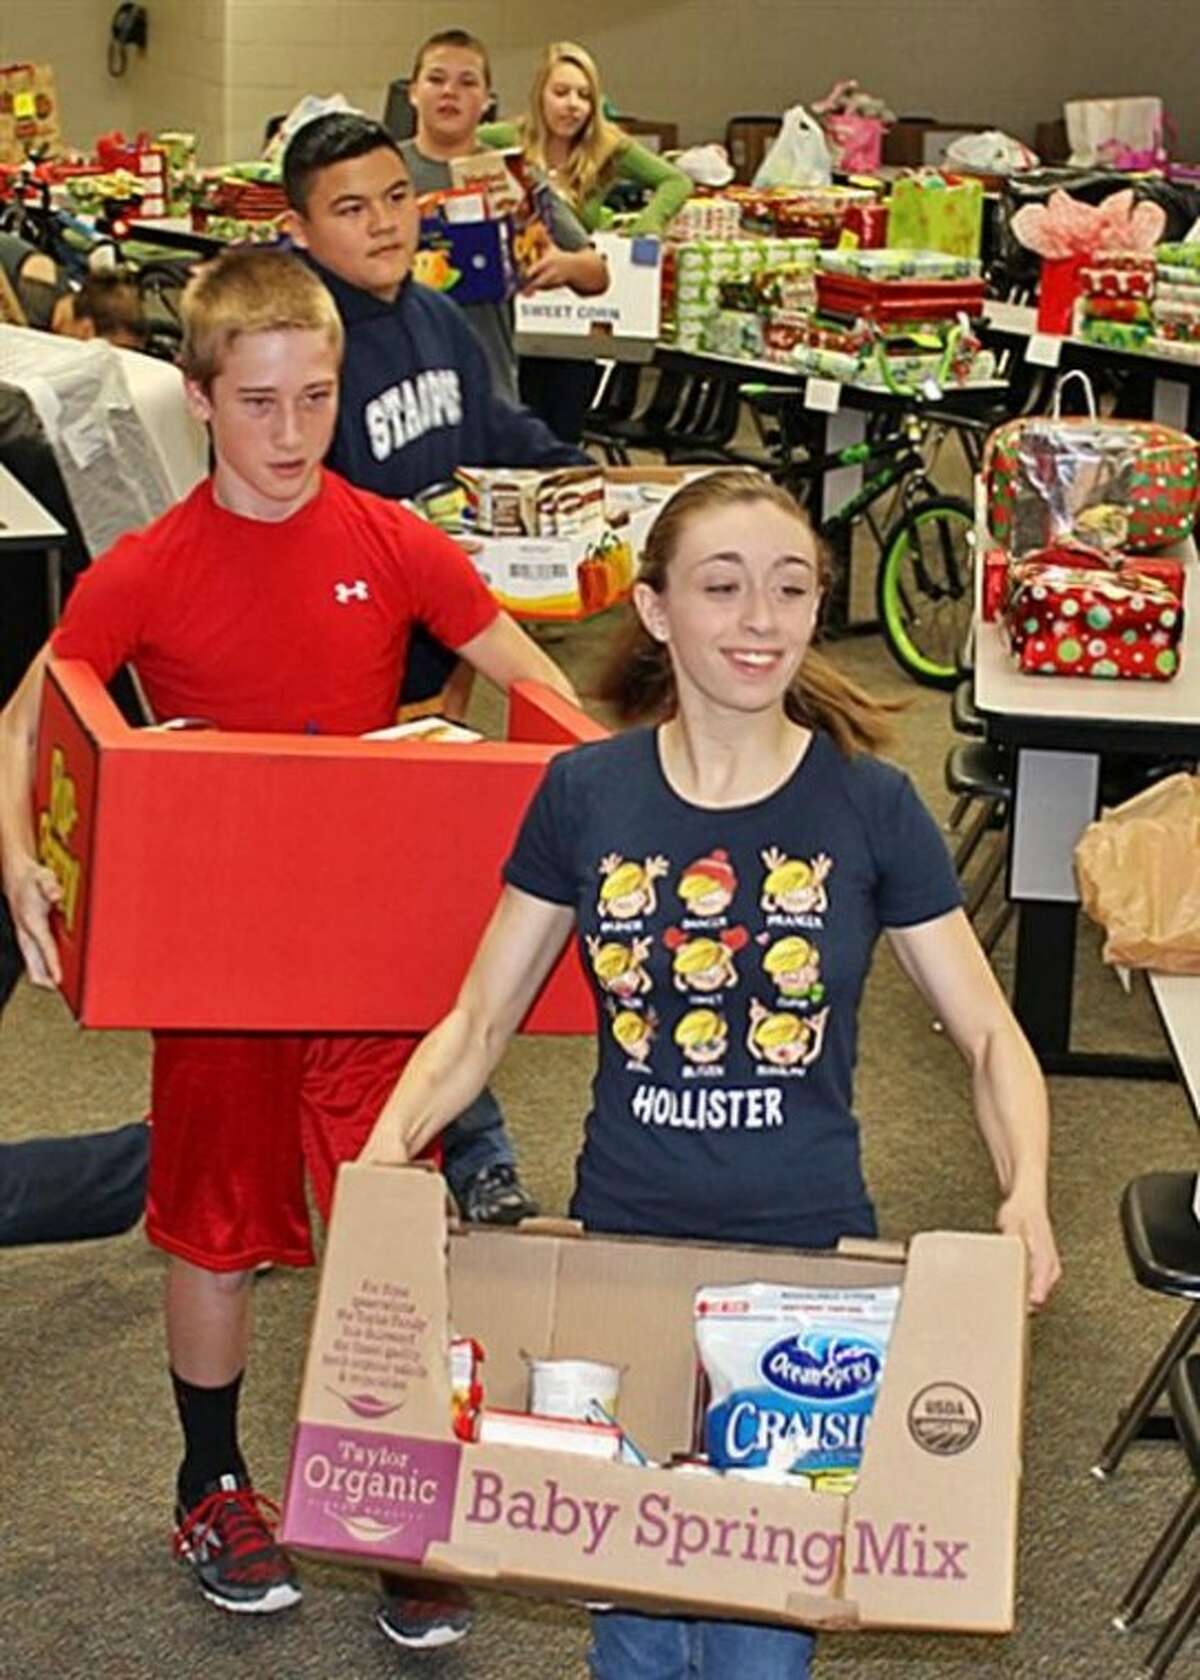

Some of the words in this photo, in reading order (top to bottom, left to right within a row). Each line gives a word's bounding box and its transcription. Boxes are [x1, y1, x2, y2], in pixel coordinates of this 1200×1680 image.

[632, 1085, 784, 1130] HOLLISTER
[769, 1352, 821, 1386] Ocean
[822, 1357, 872, 1391] Spray
[338, 1440, 411, 1468] Taylor
[726, 1402, 869, 1459] CRAISI
[304, 1454, 439, 1504] Organic
[465, 1471, 620, 1554] Baby
[634, 1493, 843, 1586] Spring
[852, 1519, 970, 1580] Mix
